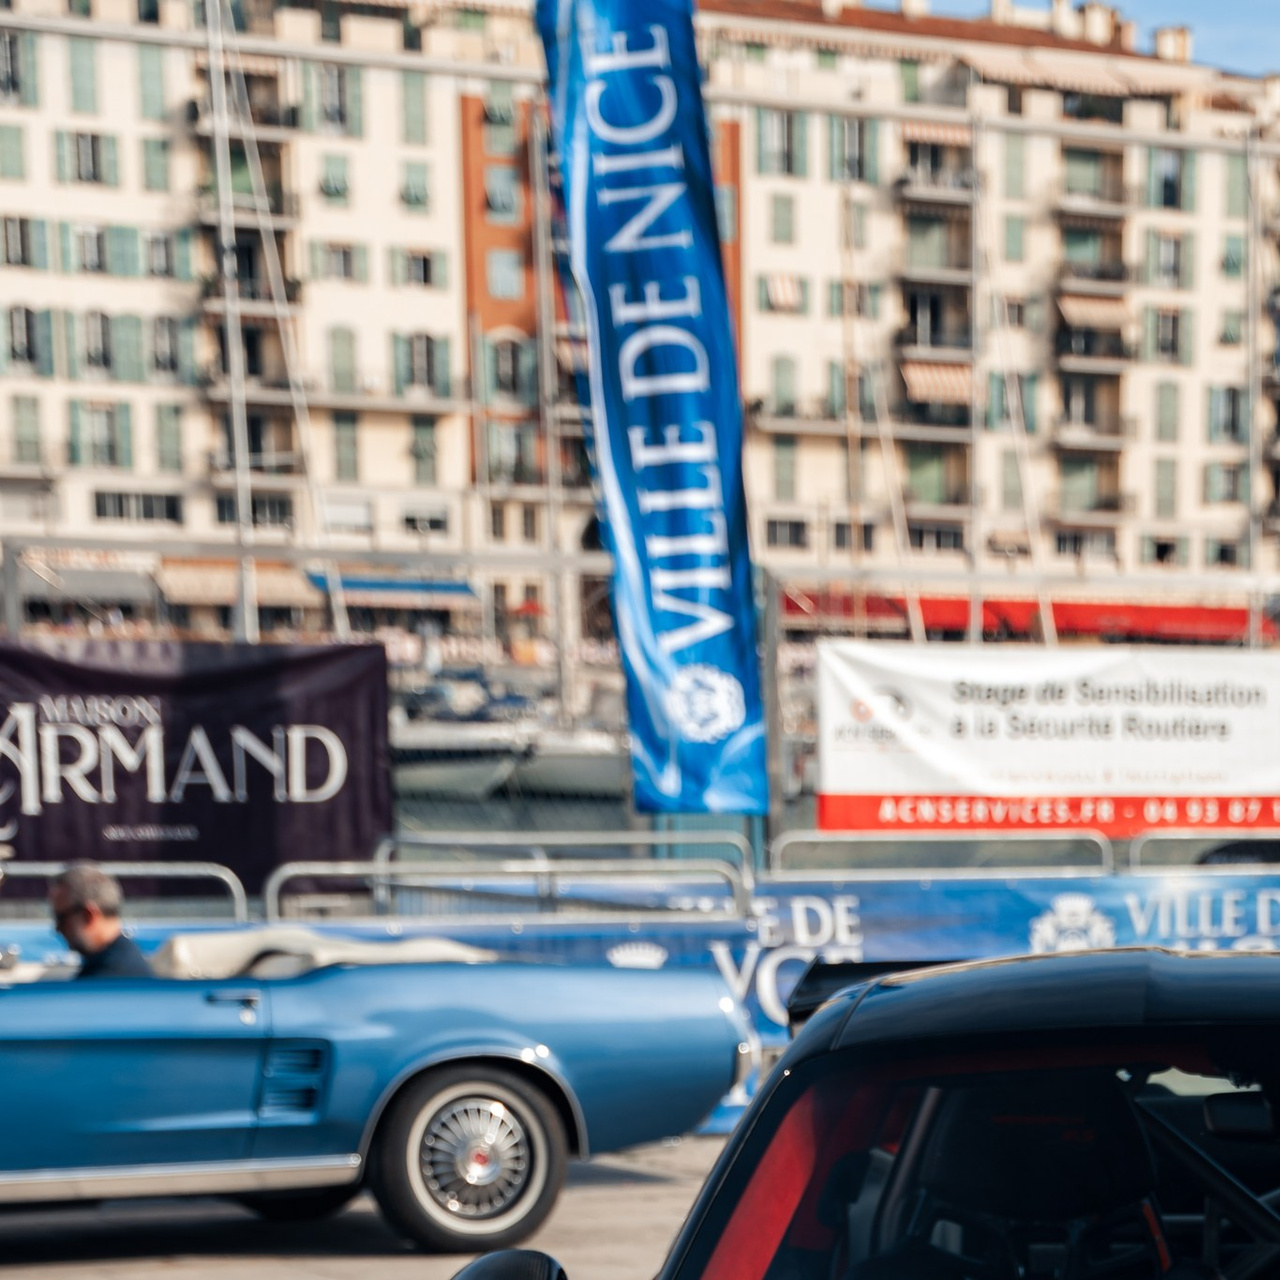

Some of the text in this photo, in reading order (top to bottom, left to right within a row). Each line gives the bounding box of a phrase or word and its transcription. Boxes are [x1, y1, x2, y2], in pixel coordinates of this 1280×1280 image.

[584, 23, 735, 653] VILLE DE NICE
[39, 694, 163, 727] MAISON
[952, 679, 1269, 711] Stage de Sensibilisation
[973, 713, 1000, 740] la
[0, 702, 348, 816] ARMAND
[1143, 797, 1178, 823] 04
[1185, 797, 1219, 824] 93
[790, 895, 864, 948] DE
[1125, 887, 1245, 939] VILLE
